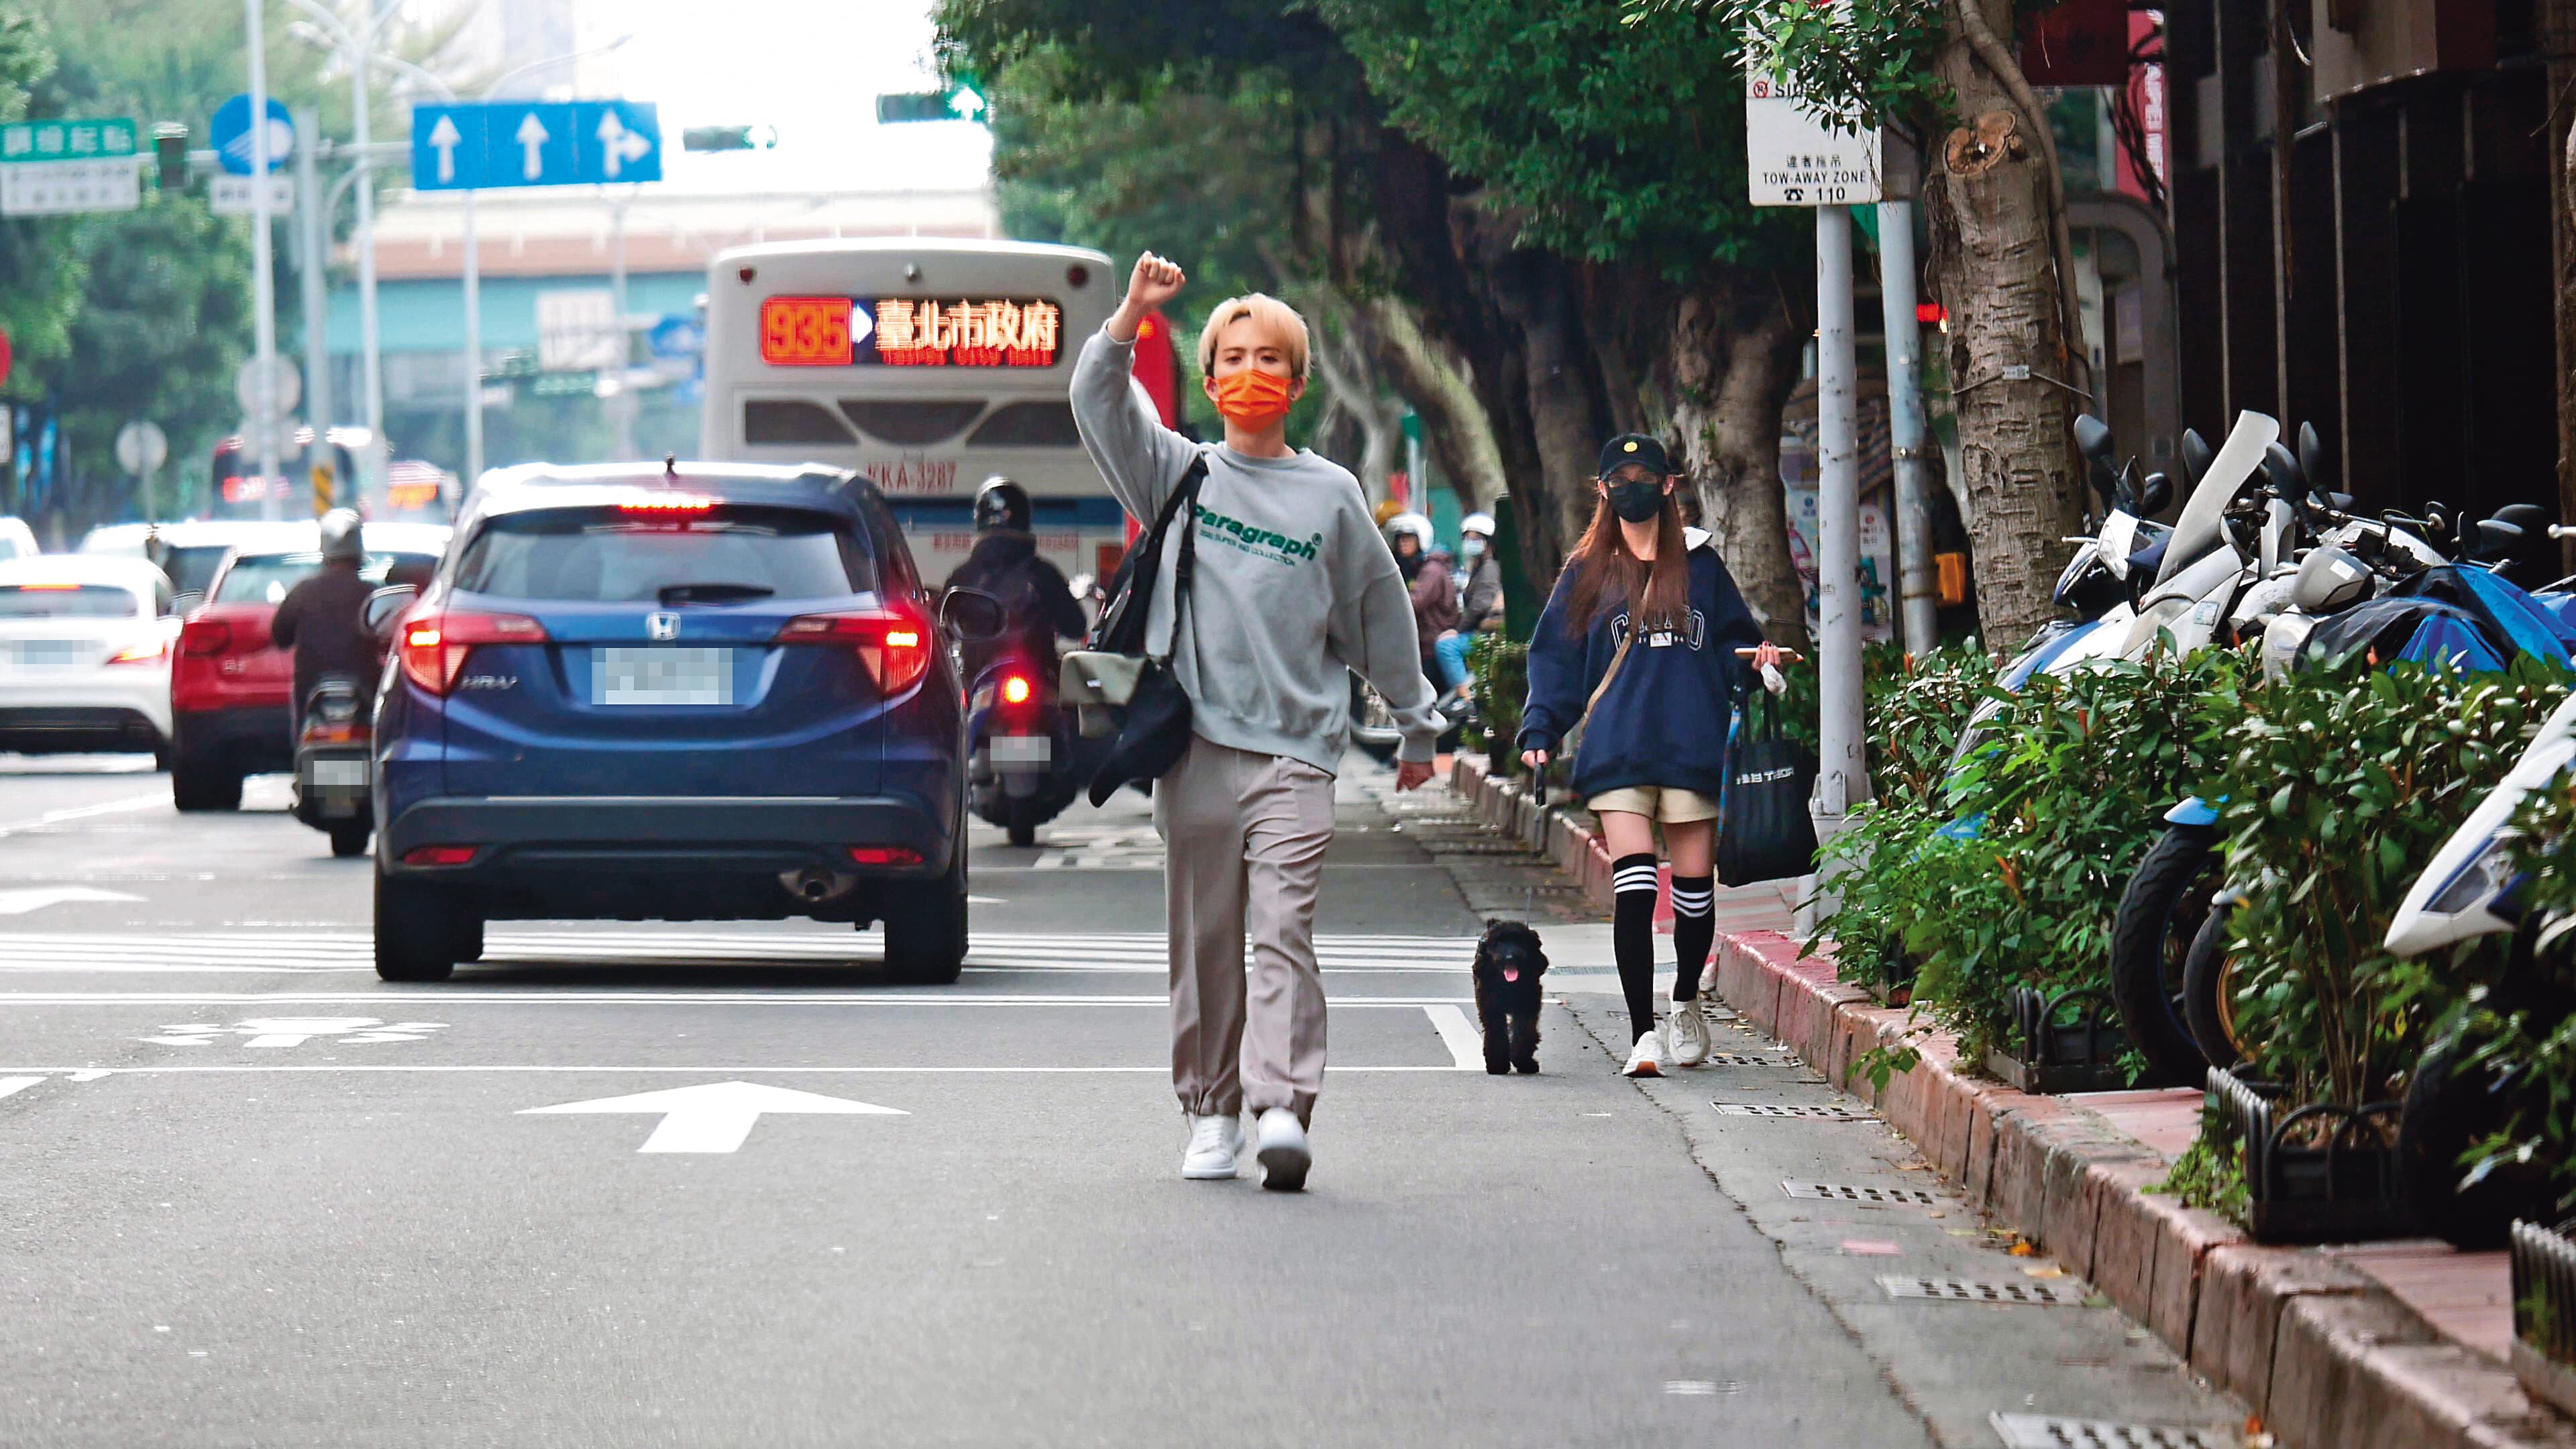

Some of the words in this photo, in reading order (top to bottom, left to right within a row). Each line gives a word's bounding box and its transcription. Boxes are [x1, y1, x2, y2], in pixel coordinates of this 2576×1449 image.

[1763, 172, 1827, 184] TOW-AWAY
[1833, 170, 1867, 184] ZONE
[1817, 186, 1845, 204] 110
[769, 304, 847, 356] 935
[875, 298, 1059, 352] 臺北市政府
